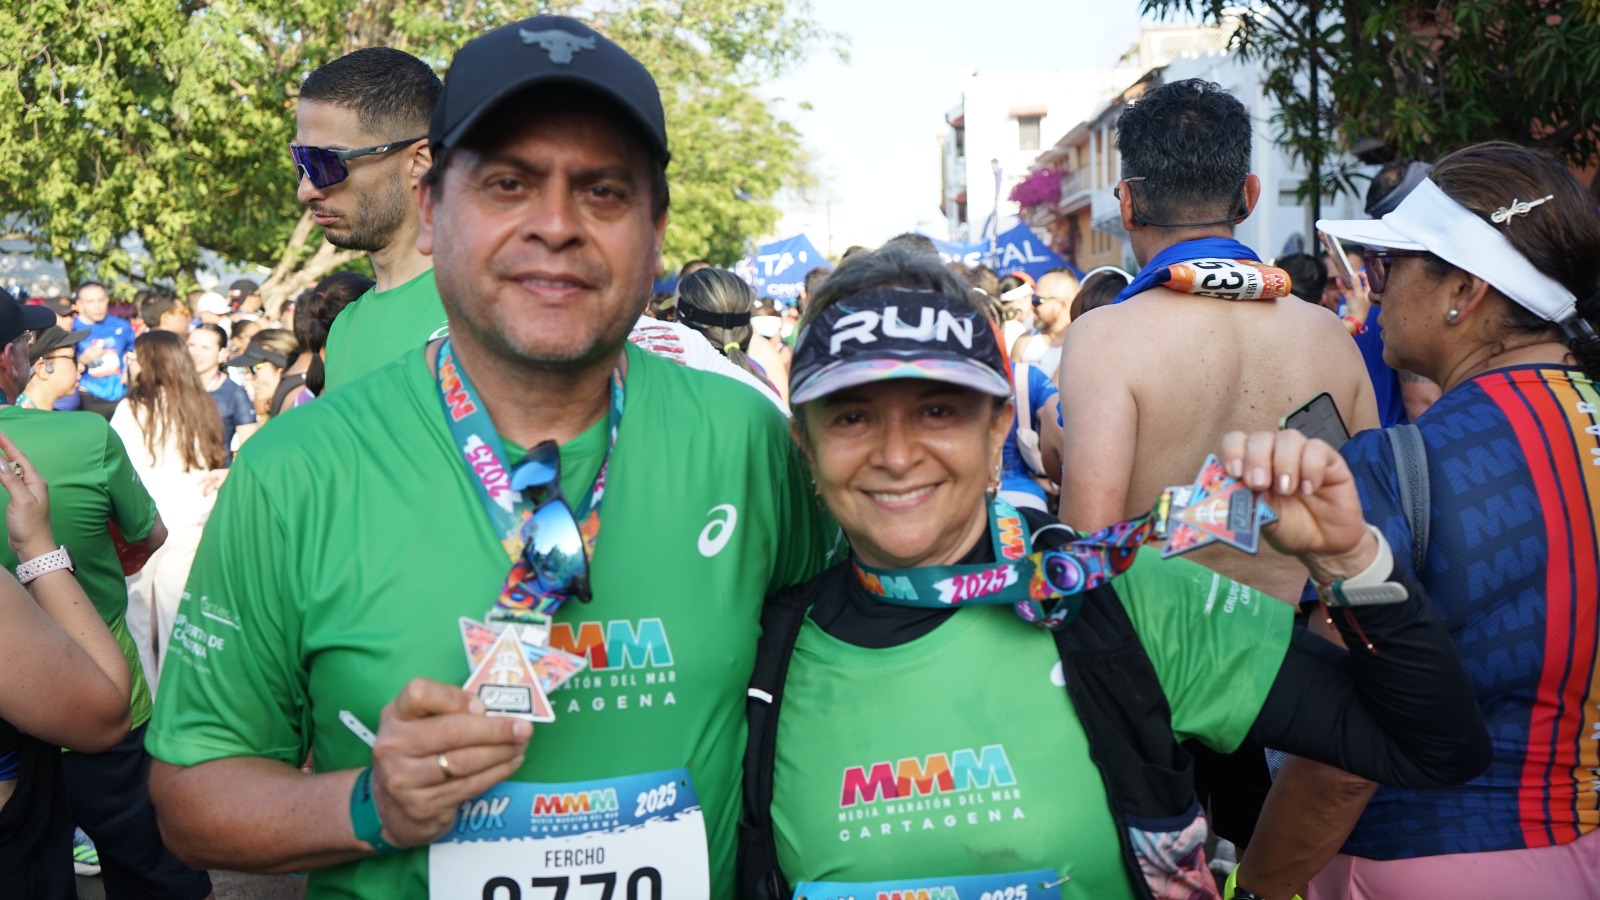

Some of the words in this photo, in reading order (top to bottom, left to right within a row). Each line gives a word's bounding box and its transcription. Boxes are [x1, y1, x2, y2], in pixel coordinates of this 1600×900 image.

[829, 306, 974, 355] RUN
[464, 444, 513, 498] 2025
[950, 564, 1009, 603] 2025
[207, 634, 225, 651] DE
[558, 676, 602, 691] ATÓN
[611, 674, 637, 687] DEL
[646, 671, 676, 684] MAR
[839, 744, 1017, 808] MMM
[457, 796, 511, 834] 10K
[530, 787, 619, 817] MMM
[634, 781, 678, 818] 2025
[838, 807, 879, 822] MEDIA
[886, 797, 951, 815] MARATÓN
[959, 794, 984, 806] DEL
[992, 789, 1021, 801] MAR
[530, 819, 619, 832] CARTAGENA
[839, 807, 1025, 842] CARTAGENA
[545, 847, 605, 868] FERCHO
